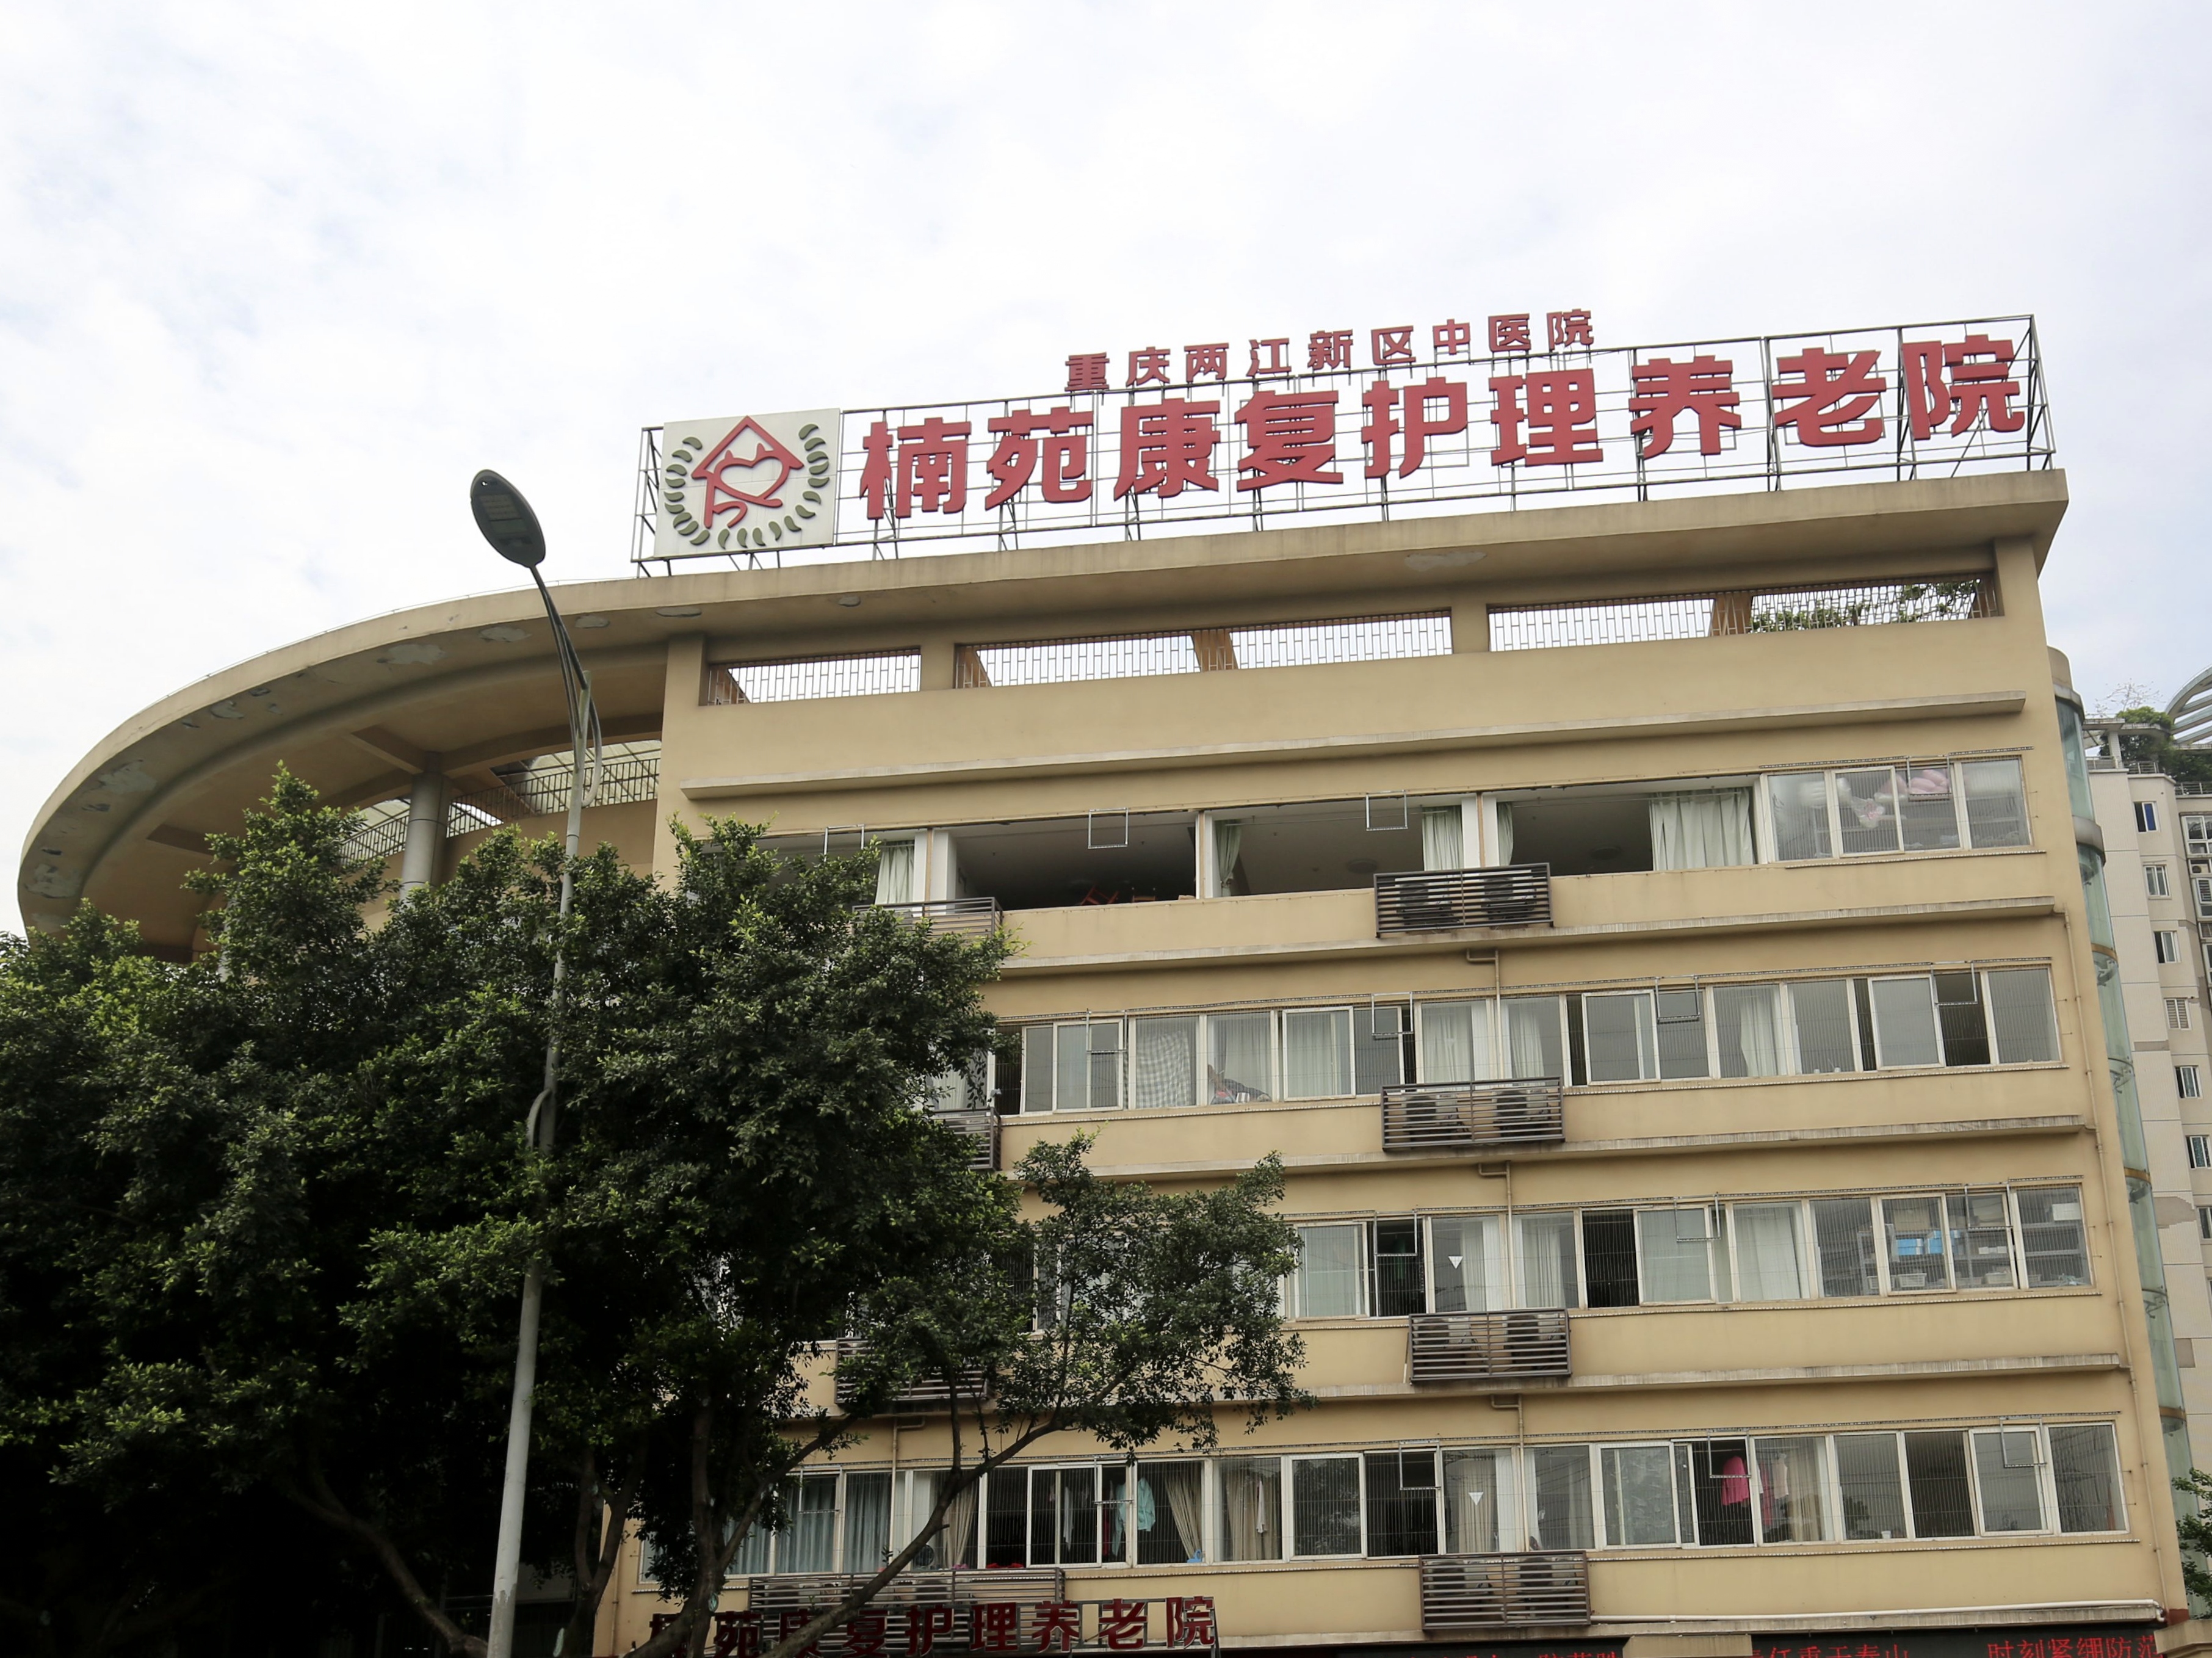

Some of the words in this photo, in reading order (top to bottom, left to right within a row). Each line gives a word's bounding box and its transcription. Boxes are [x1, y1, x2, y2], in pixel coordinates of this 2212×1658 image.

[1064, 308, 1594, 391] 重庆两江新区中医院
[859, 336, 2025, 518] 楠苑康复护理养老院
